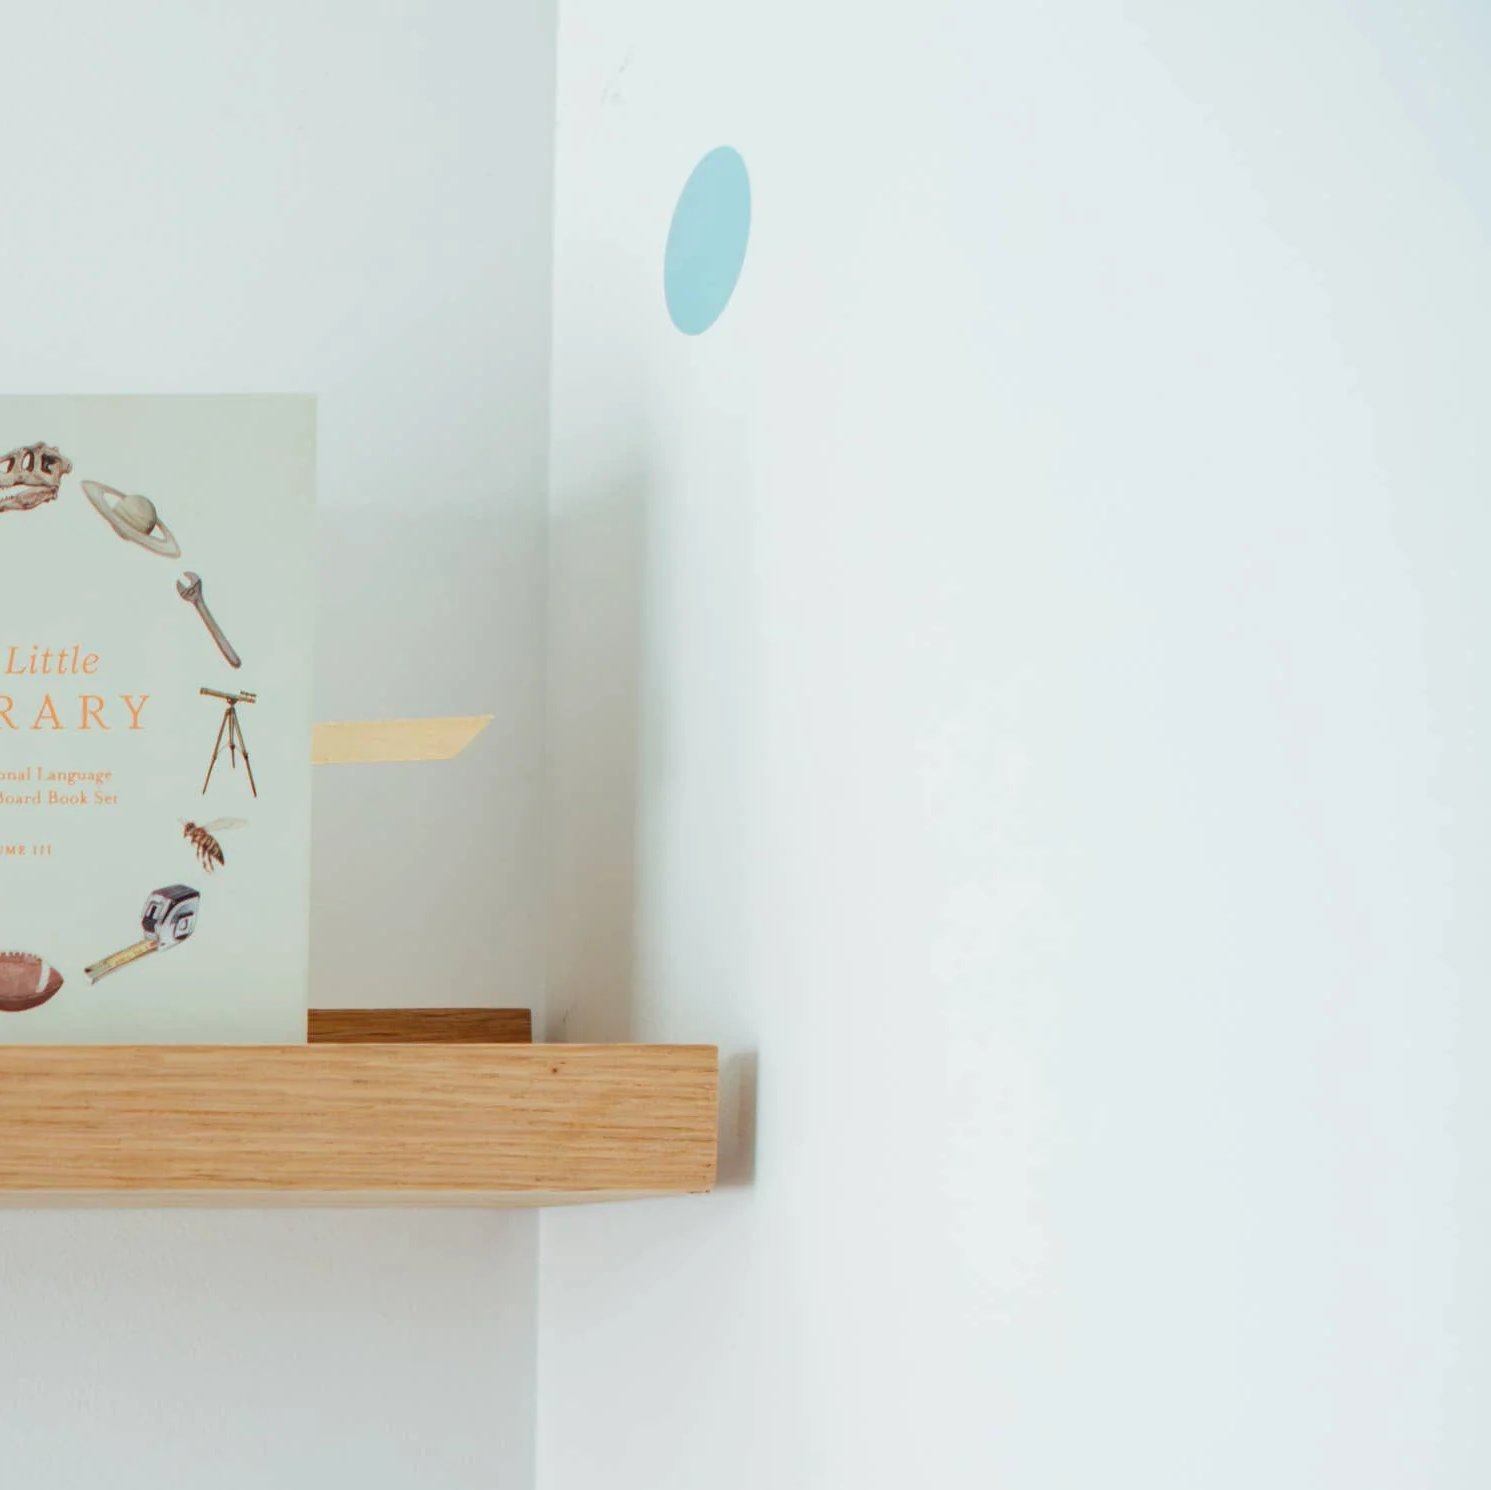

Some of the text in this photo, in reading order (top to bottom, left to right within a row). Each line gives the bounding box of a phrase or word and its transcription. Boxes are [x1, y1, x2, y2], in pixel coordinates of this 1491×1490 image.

[5, 644, 100, 675] Little
[37, 766, 112, 785] Language
[48, 790, 88, 805] Book
[94, 790, 119, 805] Set
